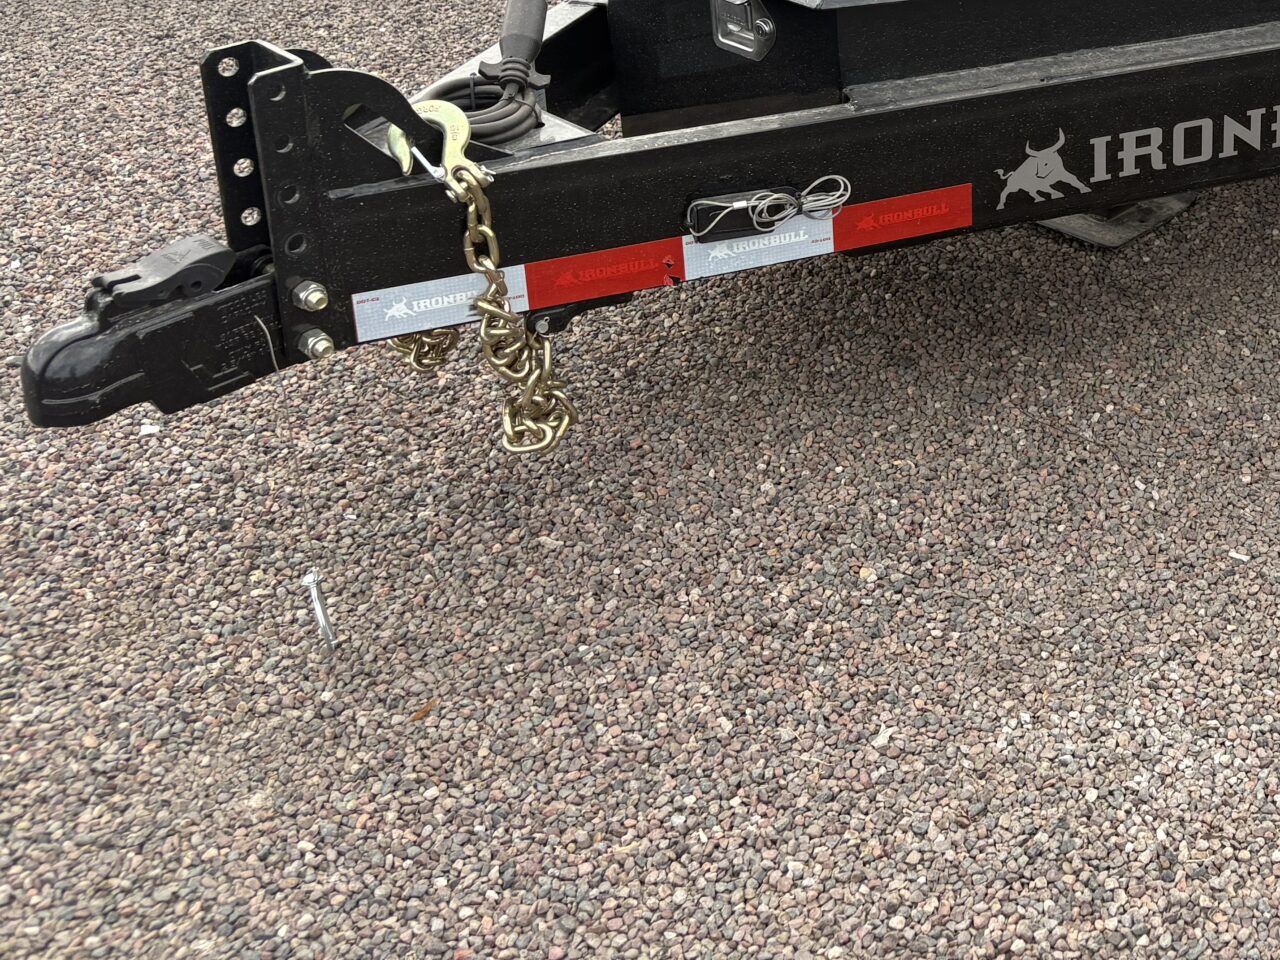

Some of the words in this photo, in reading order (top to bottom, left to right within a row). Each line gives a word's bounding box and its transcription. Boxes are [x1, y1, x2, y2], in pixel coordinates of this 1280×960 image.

[879, 203, 950, 225] IRONBULL
[732, 230, 809, 253] IRONBULL
[578, 260, 659, 281] IRONBULL
[412, 290, 478, 313] IRONBU
